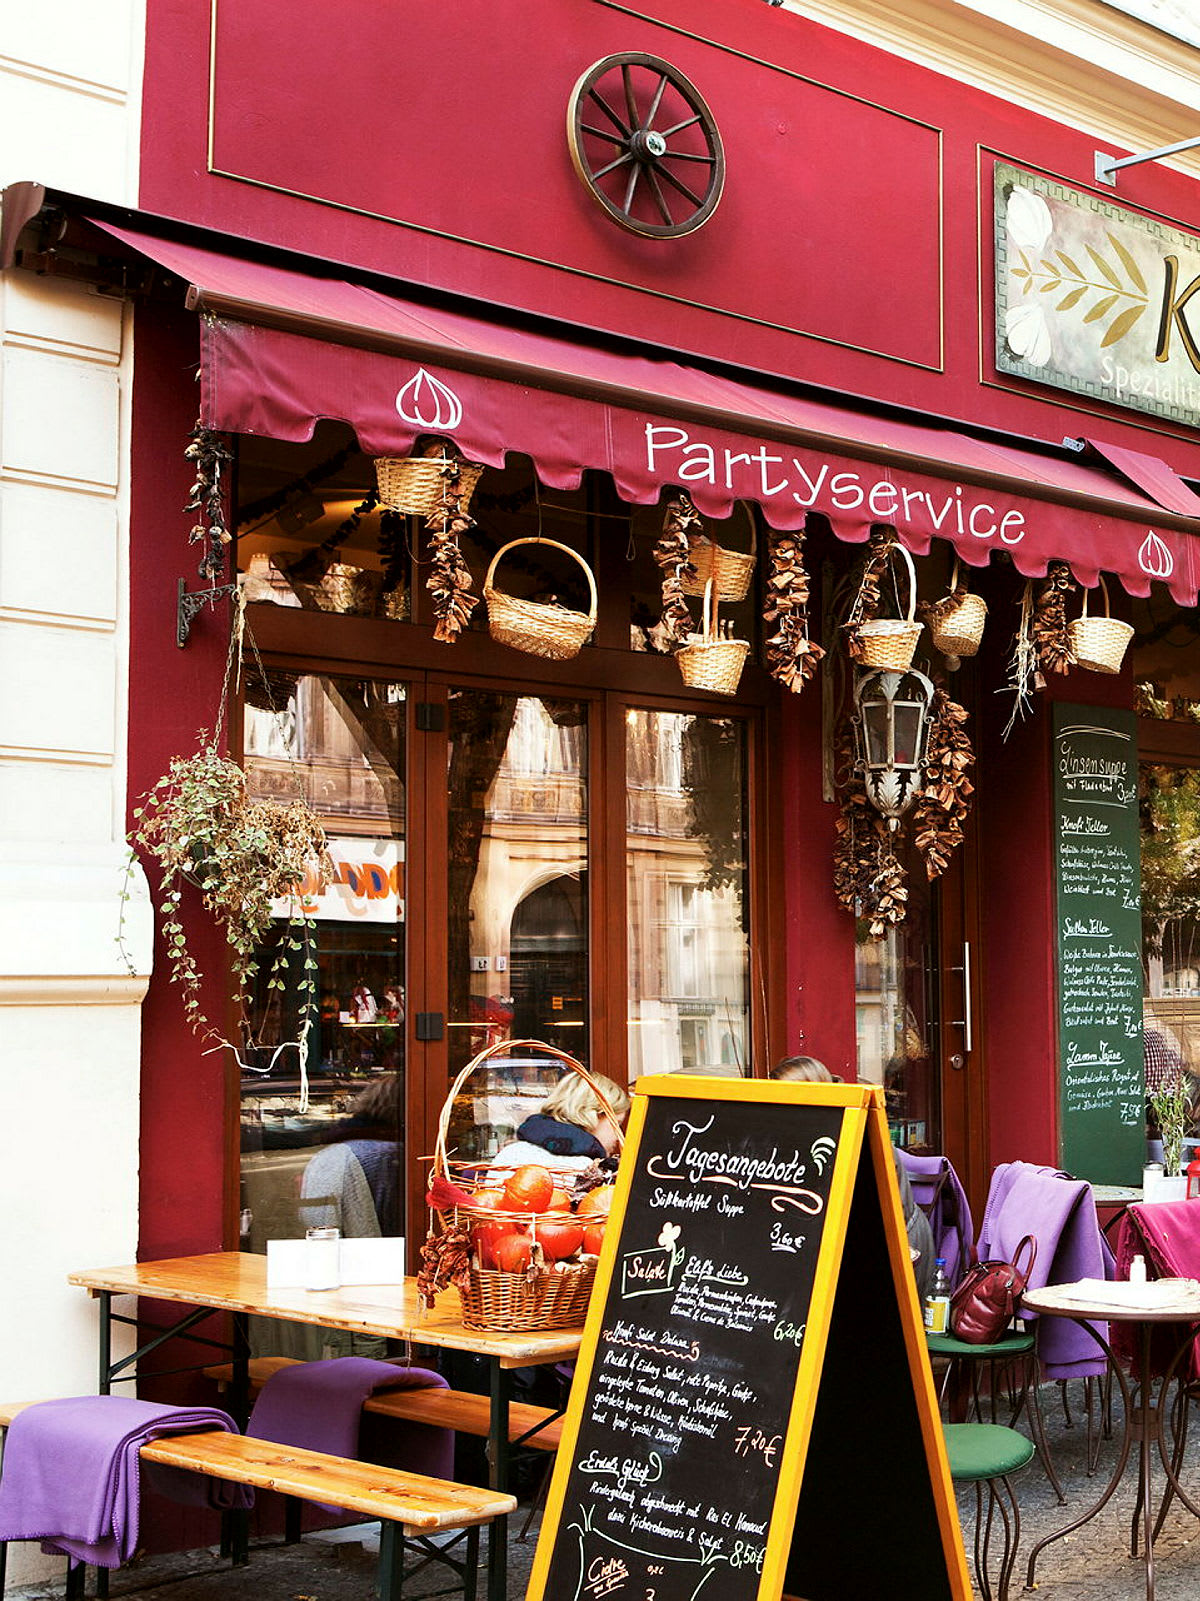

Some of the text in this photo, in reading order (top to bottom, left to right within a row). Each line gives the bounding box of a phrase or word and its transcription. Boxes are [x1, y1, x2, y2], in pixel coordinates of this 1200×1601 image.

[644, 422, 1027, 545] Partyservice
[1061, 815, 1085, 832] Knofi
[667, 1114, 806, 1190] Tagesangebote
[717, 1194, 745, 1218] Suppe
[627, 1256, 667, 1280] Salate
